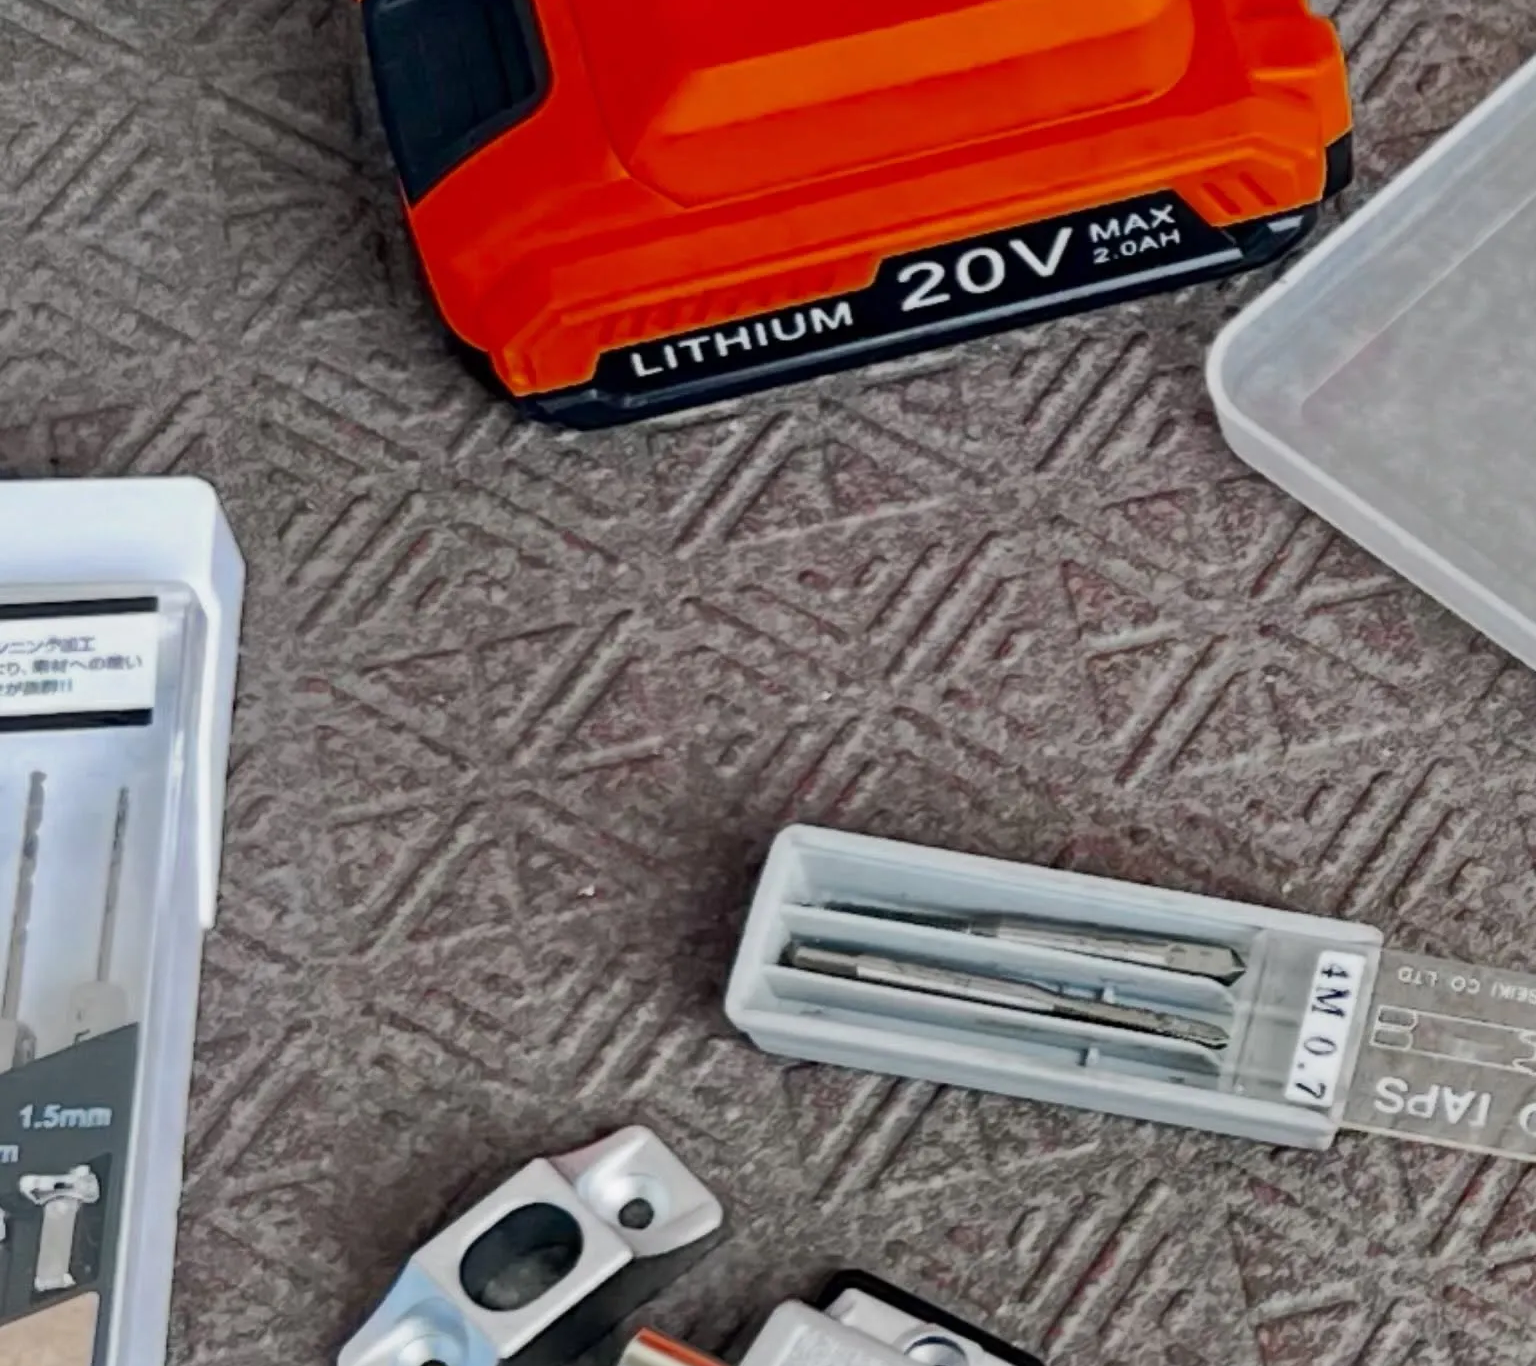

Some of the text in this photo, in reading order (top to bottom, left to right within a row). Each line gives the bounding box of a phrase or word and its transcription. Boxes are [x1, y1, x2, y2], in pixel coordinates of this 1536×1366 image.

[1090, 204, 1176, 244] MAX
[1093, 229, 1181, 264] 2.0AH
[630, 227, 1073, 377] LITHIUM 20V
[1398, 966, 1438, 988] LTD
[1451, 974, 1480, 995] CO
[1296, 963, 1351, 1100] 4M 0.7
[20, 1104, 112, 1129] 1.5mm
